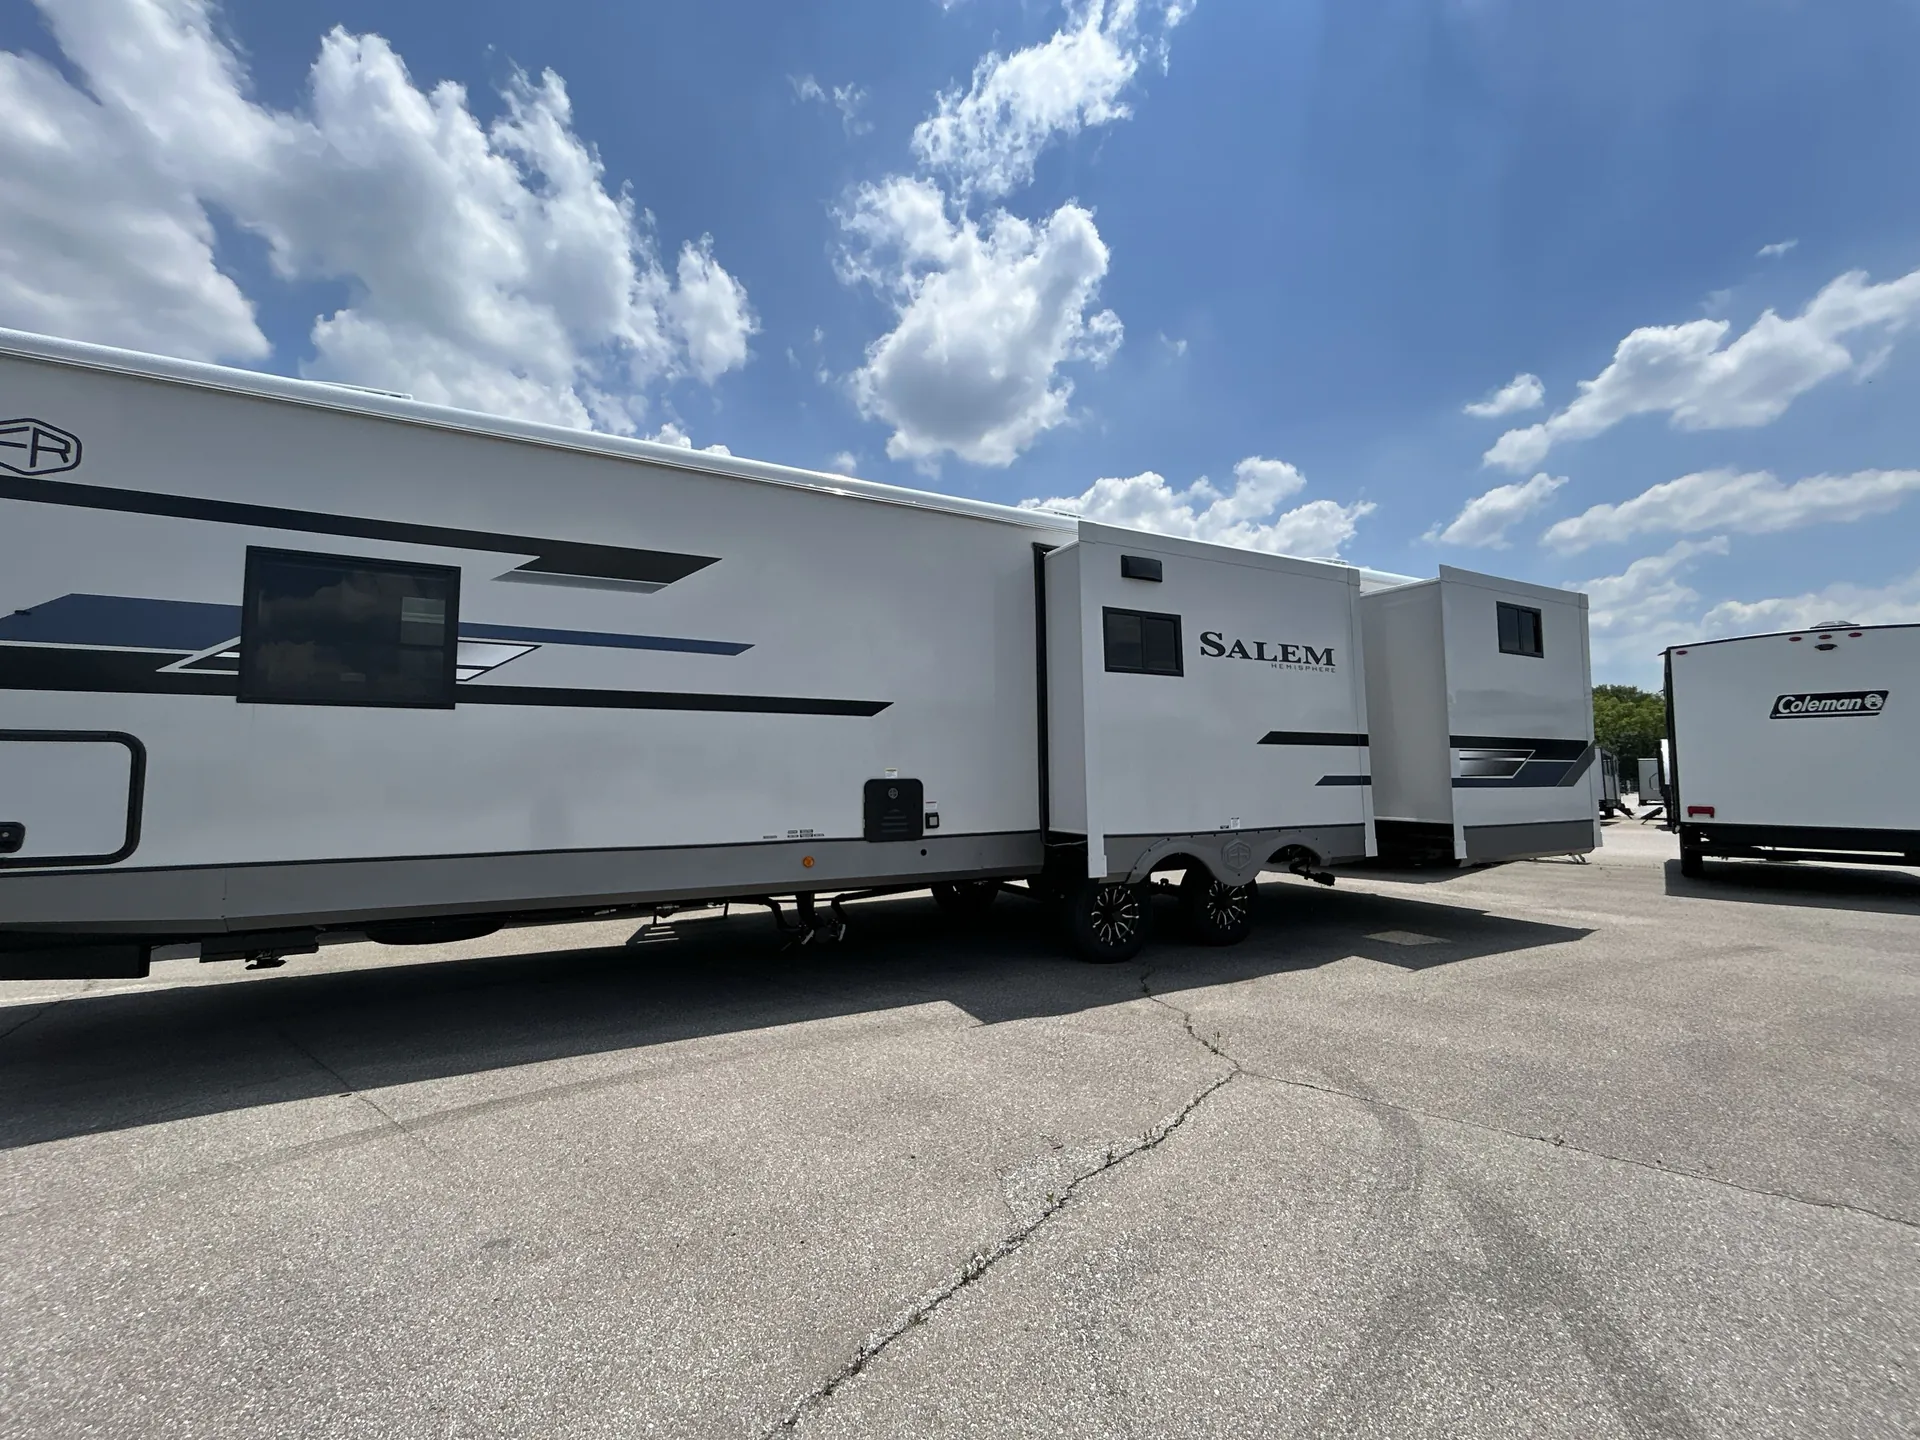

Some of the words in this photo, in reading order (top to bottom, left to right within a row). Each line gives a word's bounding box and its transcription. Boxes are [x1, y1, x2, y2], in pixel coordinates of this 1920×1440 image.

[1199, 631, 1336, 667] SALEM
[1270, 663, 1336, 674] HEMISPHERE
[1778, 696, 1862, 713] Coleman
